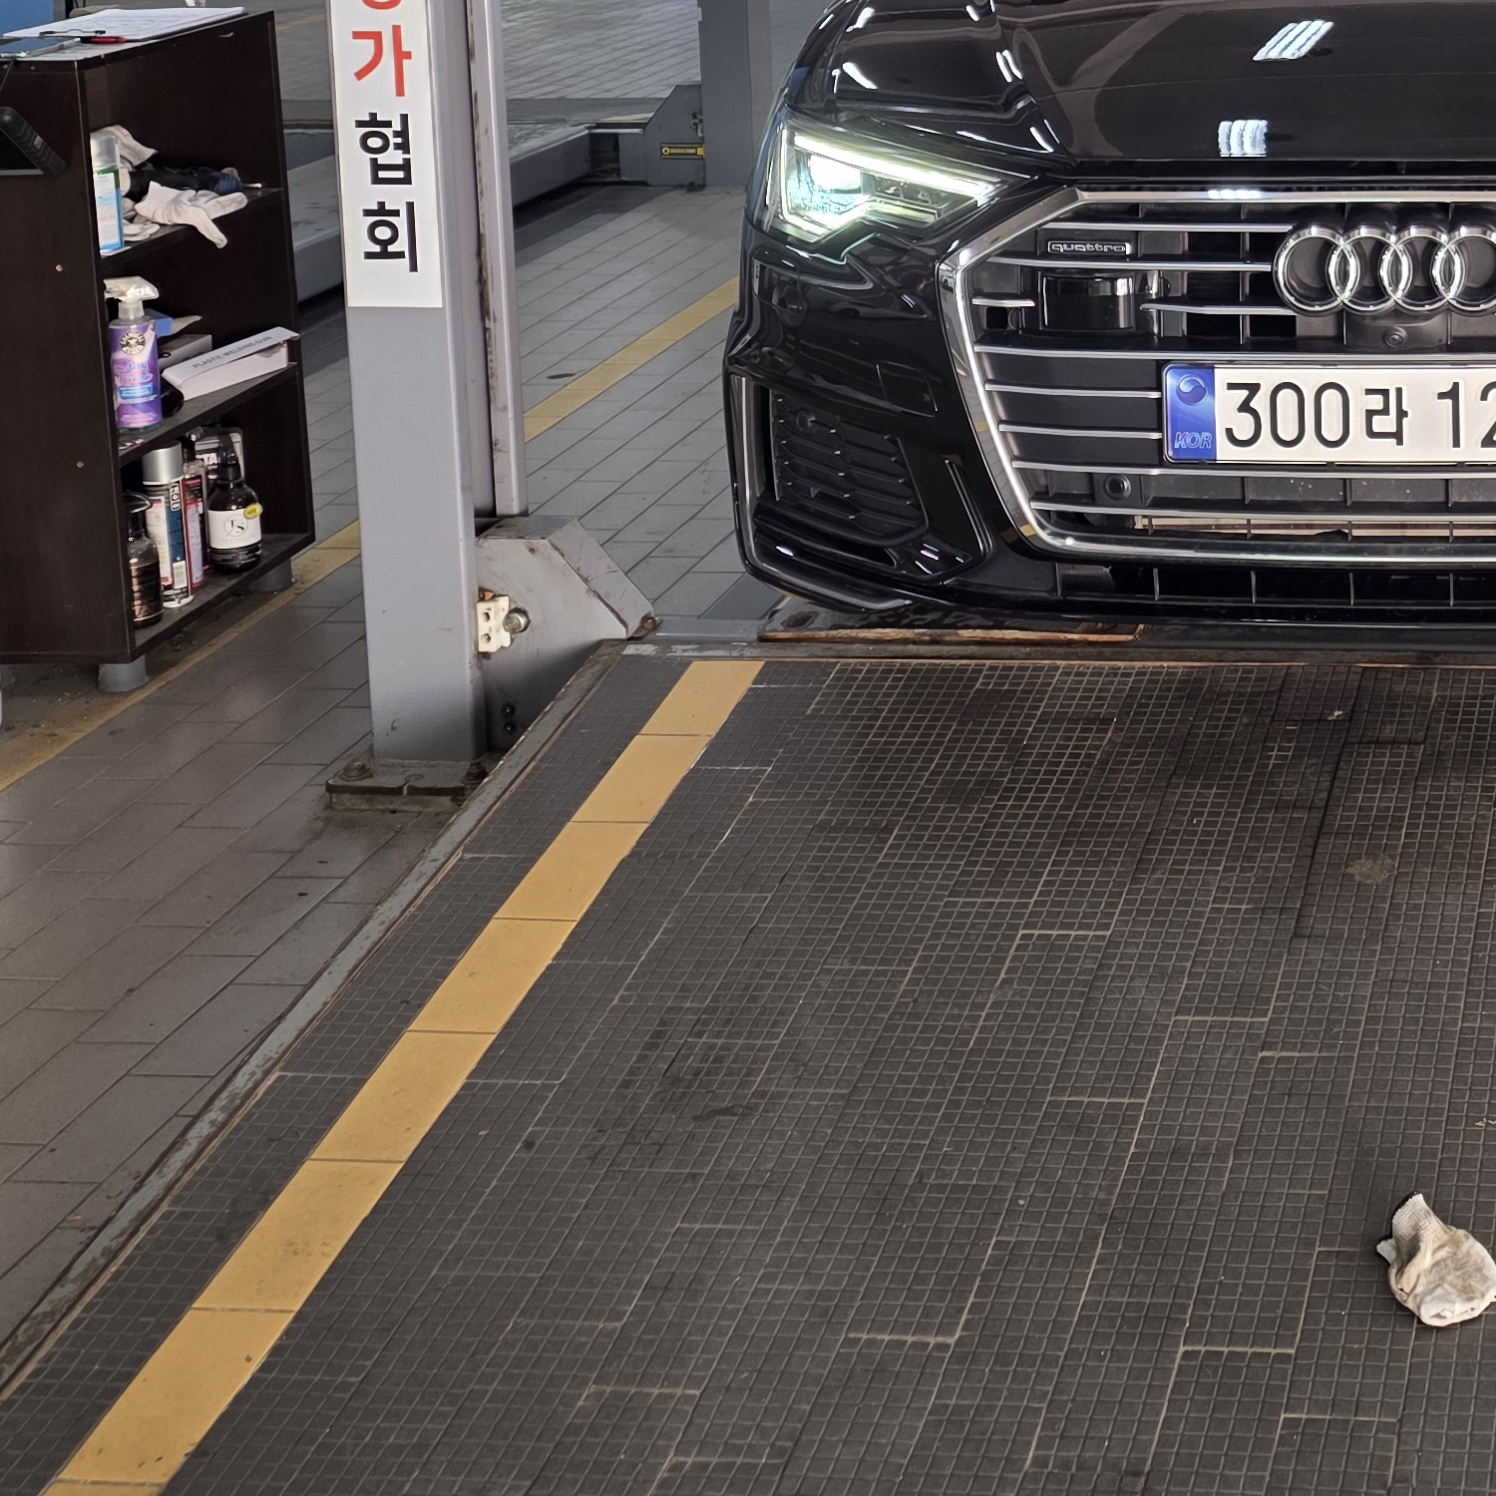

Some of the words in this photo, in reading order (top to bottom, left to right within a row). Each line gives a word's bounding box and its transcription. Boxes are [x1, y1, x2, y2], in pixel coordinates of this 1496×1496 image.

[1051, 242, 1126, 253] quattro
[1224, 380, 1409, 449] 300라
[1173, 429, 1213, 450] KOR
